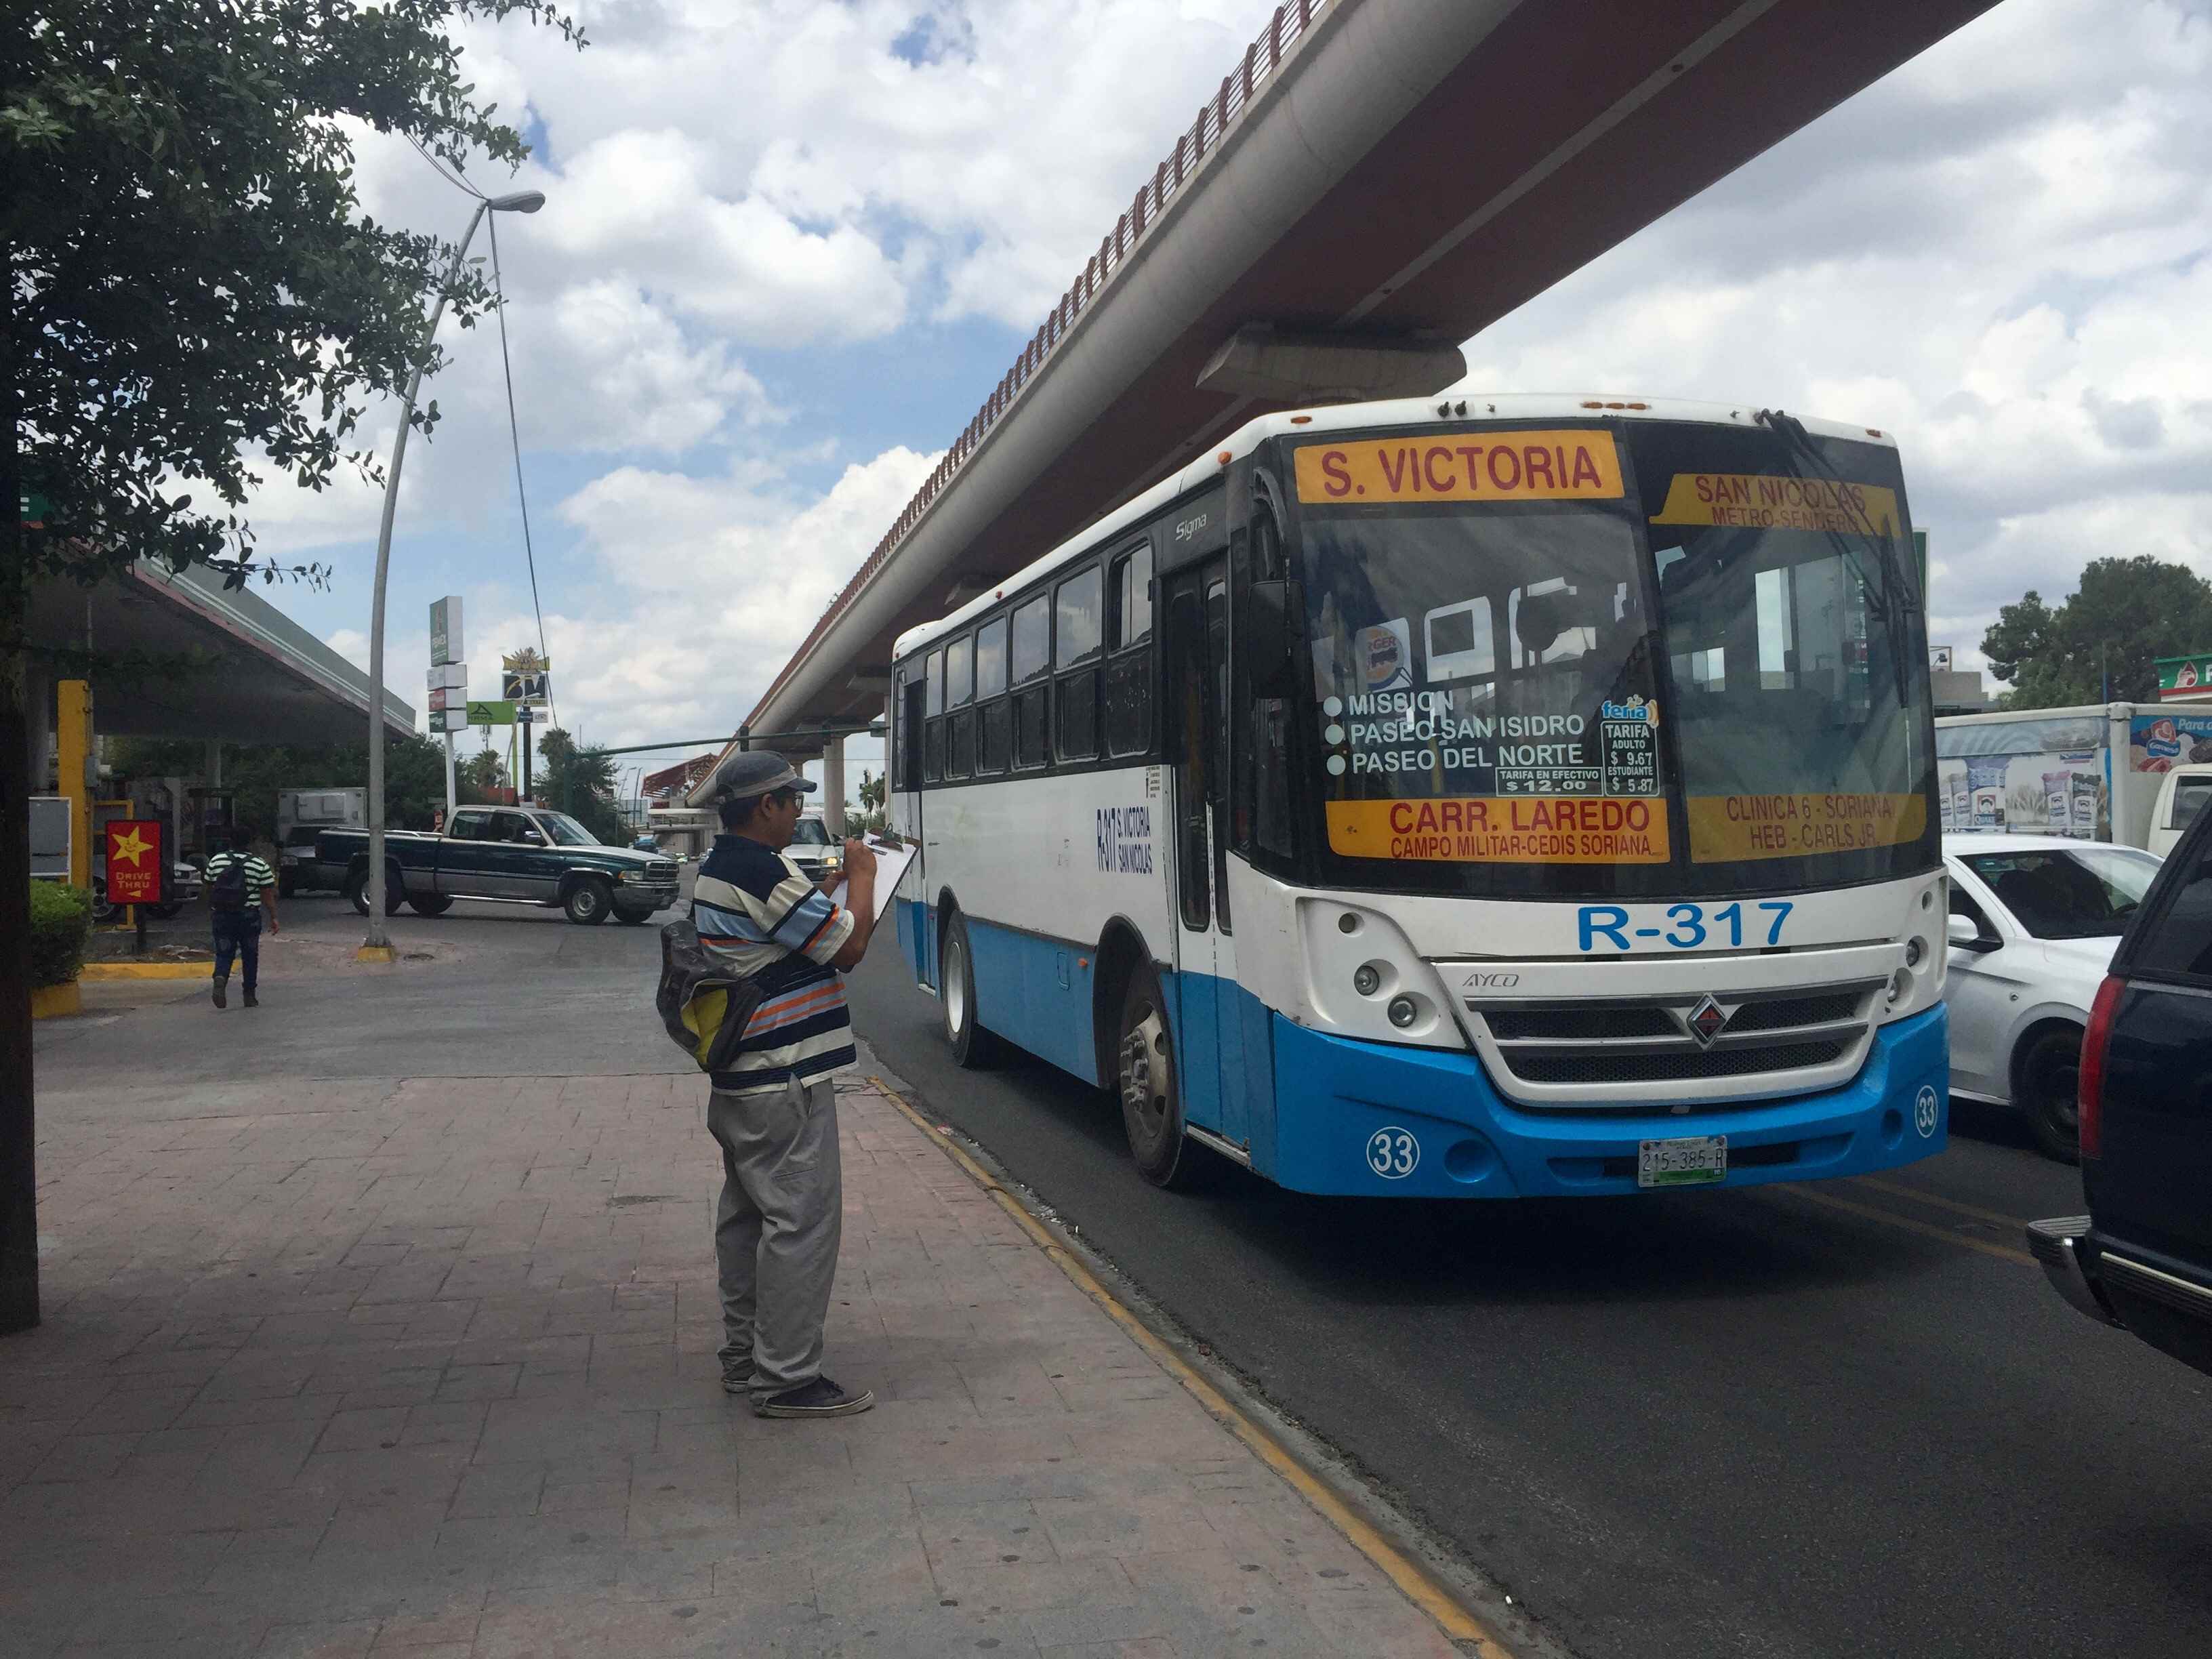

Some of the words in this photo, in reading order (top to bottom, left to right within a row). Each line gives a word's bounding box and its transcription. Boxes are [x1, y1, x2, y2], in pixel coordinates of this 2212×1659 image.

[1321, 450, 1365, 497] S.
[1378, 445, 1602, 493] VICTORIA
[1695, 476, 1752, 505] SAN
[1758, 479, 1865, 511] NICOLAS
[1175, 514, 1207, 541] Sigma
[1348, 690, 1454, 716] MISSION
[1351, 720, 1434, 745] PASEO
[1441, 715, 1492, 740] SAN
[1500, 714, 1584, 737] ISIDRO
[1605, 724, 1650, 739] TARIFA
[2177, 718, 2205, 731] Para
[1353, 748, 1436, 773] PASEO
[1443, 747, 1493, 769] DEL
[1498, 743, 1584, 766] NORTE
[1612, 739, 1646, 750] ADULTO
[1607, 766, 1654, 776] ESTUDIANTE
[1610, 751, 1618, 766] $
[1626, 752, 1653, 766] 9.67
[1500, 770, 1534, 779] TARIFA
[1536, 770, 1551, 779] EN
[1552, 770, 1599, 779] EFECTIVO
[1506, 781, 1519, 792] $
[1523, 779, 1587, 792] 12.00
[1612, 776, 1620, 792] $
[1627, 778, 1654, 792] 5.87
[1117, 808, 1123, 838] S.
[1123, 806, 1151, 838] VICTORIA
[1389, 800, 1499, 834] CARR.
[1510, 800, 1651, 832] LAREDO
[1726, 796, 1798, 822] CLINICA
[1801, 796, 1811, 819] 6
[1826, 795, 1893, 820] SORIANA
[1097, 808, 1117, 872] R-317
[1390, 836, 1452, 859] CAMPO
[1456, 835, 1576, 857] MILITAR-CEDIS
[1580, 834, 1652, 857] SORIANA
[1750, 824, 1787, 850] HEB
[1801, 823, 1855, 848] CARLS
[1118, 844, 1130, 874] SAN
[1130, 843, 1152, 874] NICOLAS
[116, 872, 152, 880] DRIVE
[1578, 902, 1794, 951] R-317
[1462, 973, 1519, 987] AYCO
[1919, 1095, 1935, 1128] 33
[1373, 1133, 1413, 1173] 33
